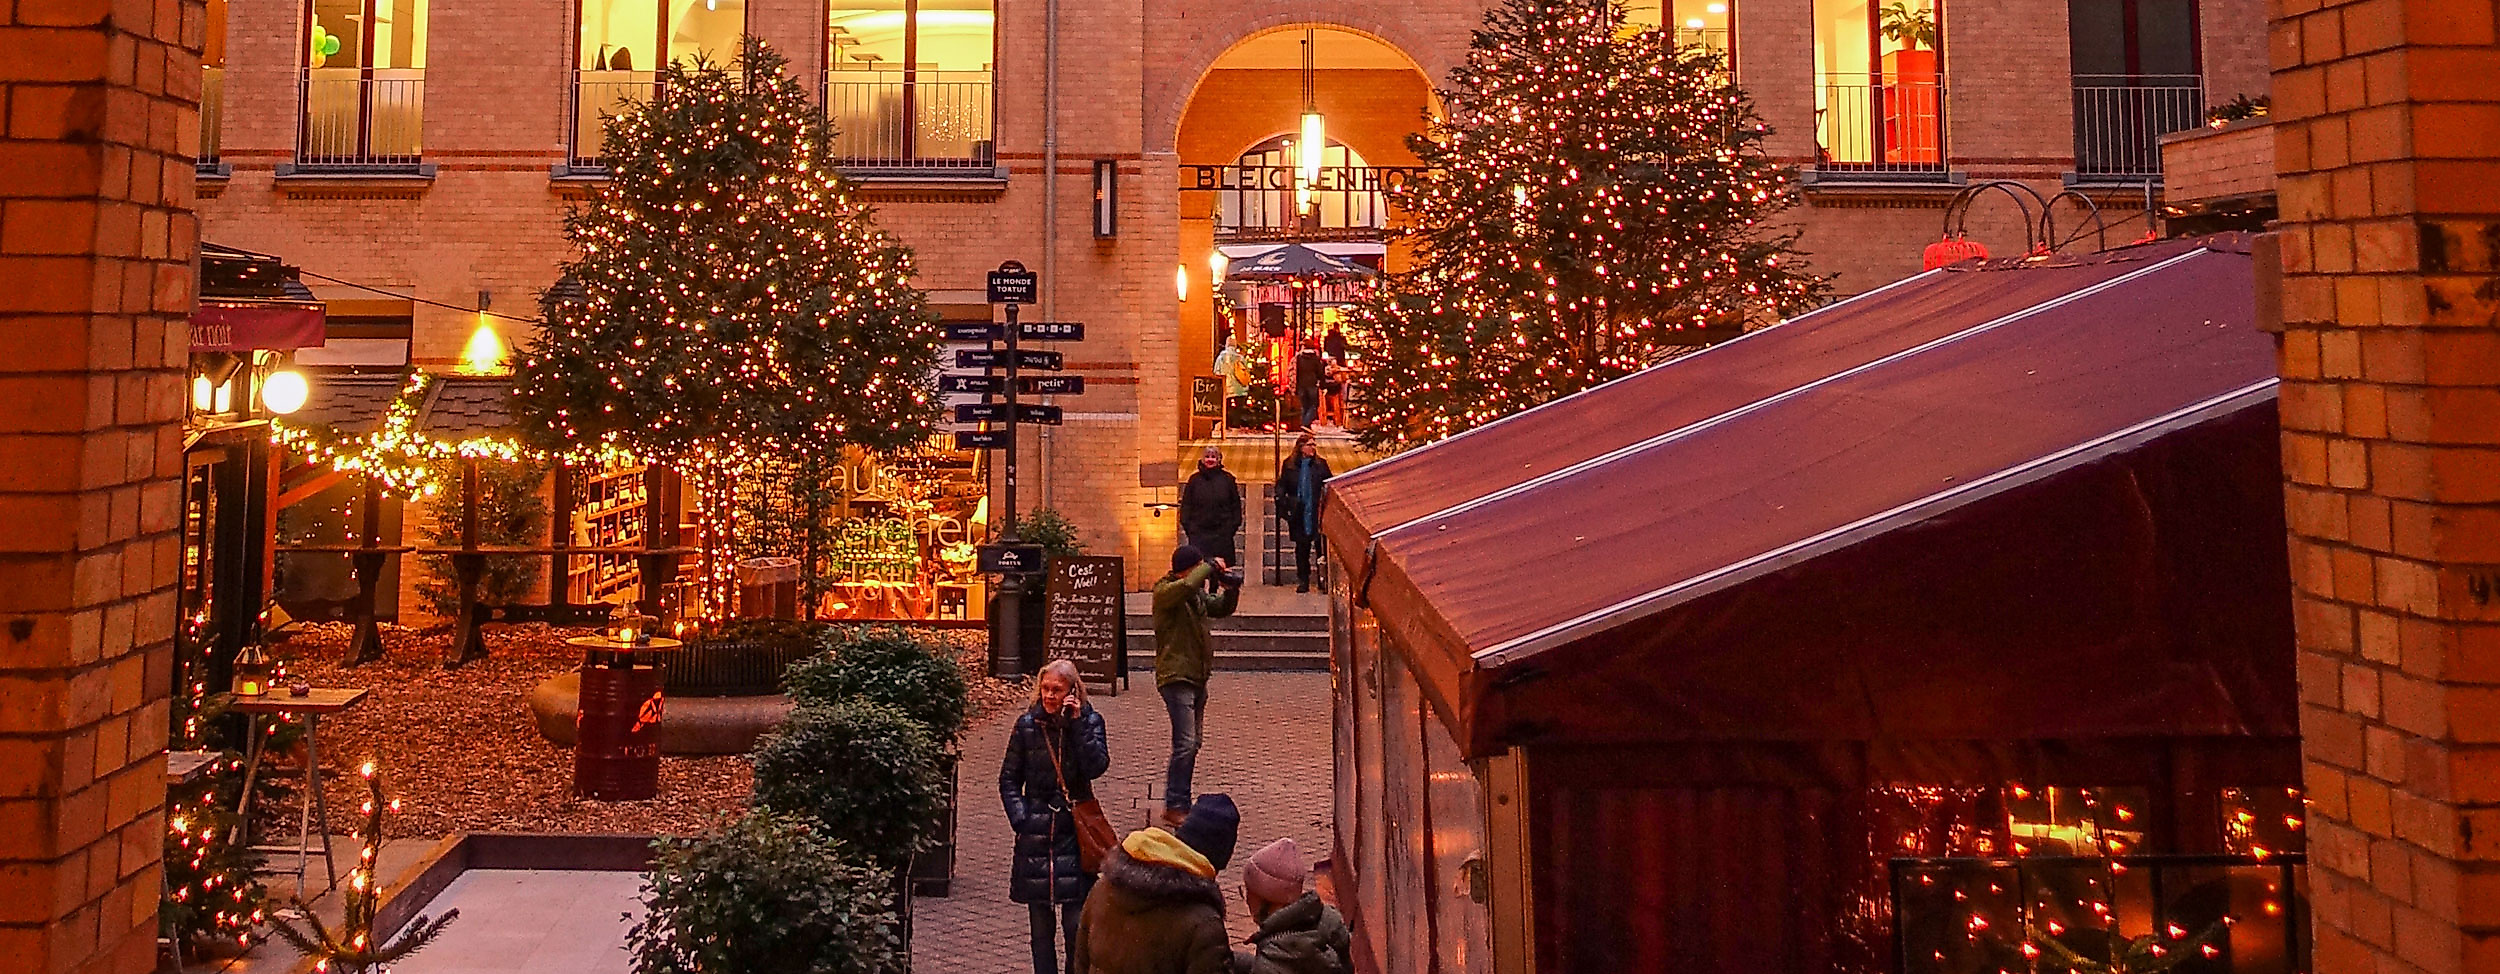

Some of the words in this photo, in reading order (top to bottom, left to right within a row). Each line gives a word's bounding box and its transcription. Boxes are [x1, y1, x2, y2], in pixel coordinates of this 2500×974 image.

[825, 464, 899, 494] aus
[827, 508, 979, 547] reicher
[1068, 563, 1094, 578] C'est
